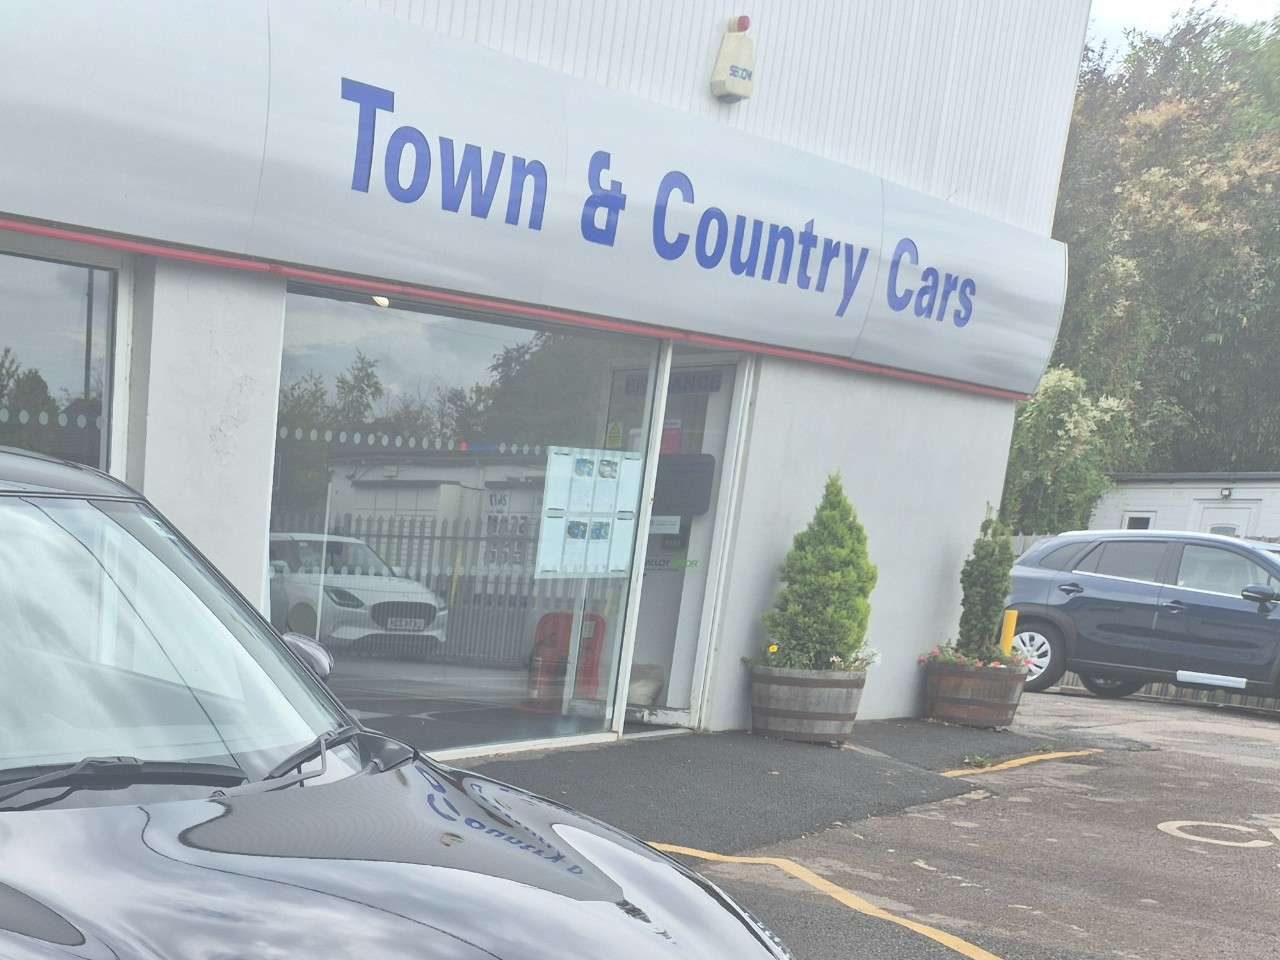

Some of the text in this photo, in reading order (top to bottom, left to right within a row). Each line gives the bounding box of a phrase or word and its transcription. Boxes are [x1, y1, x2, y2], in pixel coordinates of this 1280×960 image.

[340, 77, 978, 328] Town & Country Cars
